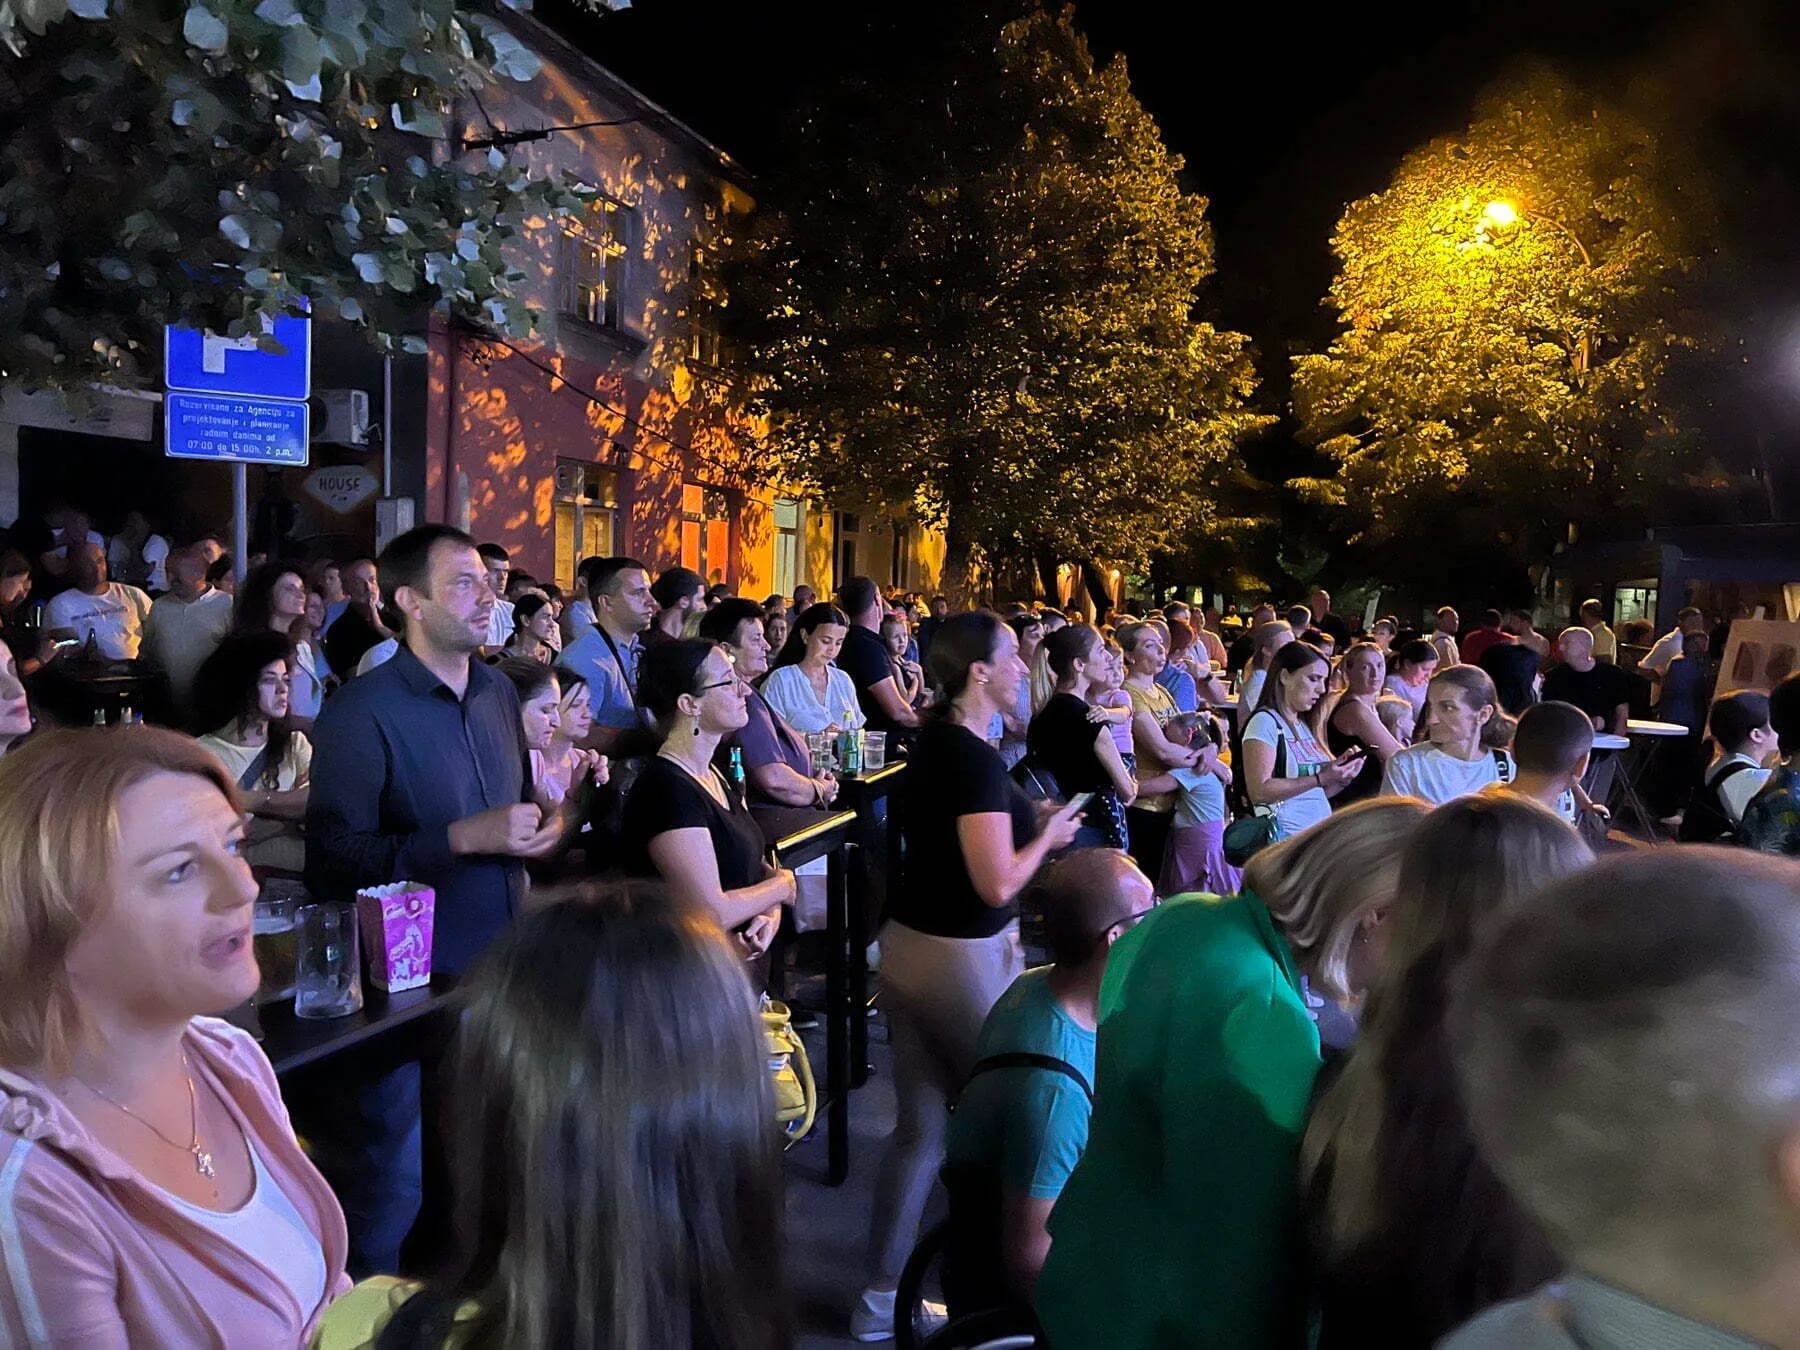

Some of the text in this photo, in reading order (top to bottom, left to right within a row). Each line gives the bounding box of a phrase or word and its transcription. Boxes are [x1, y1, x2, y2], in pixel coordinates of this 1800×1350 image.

[266, 432, 276, 442] od
[217, 443, 227, 452] do
[266, 446, 272, 455] 2
[320, 477, 361, 492] HOUSE
